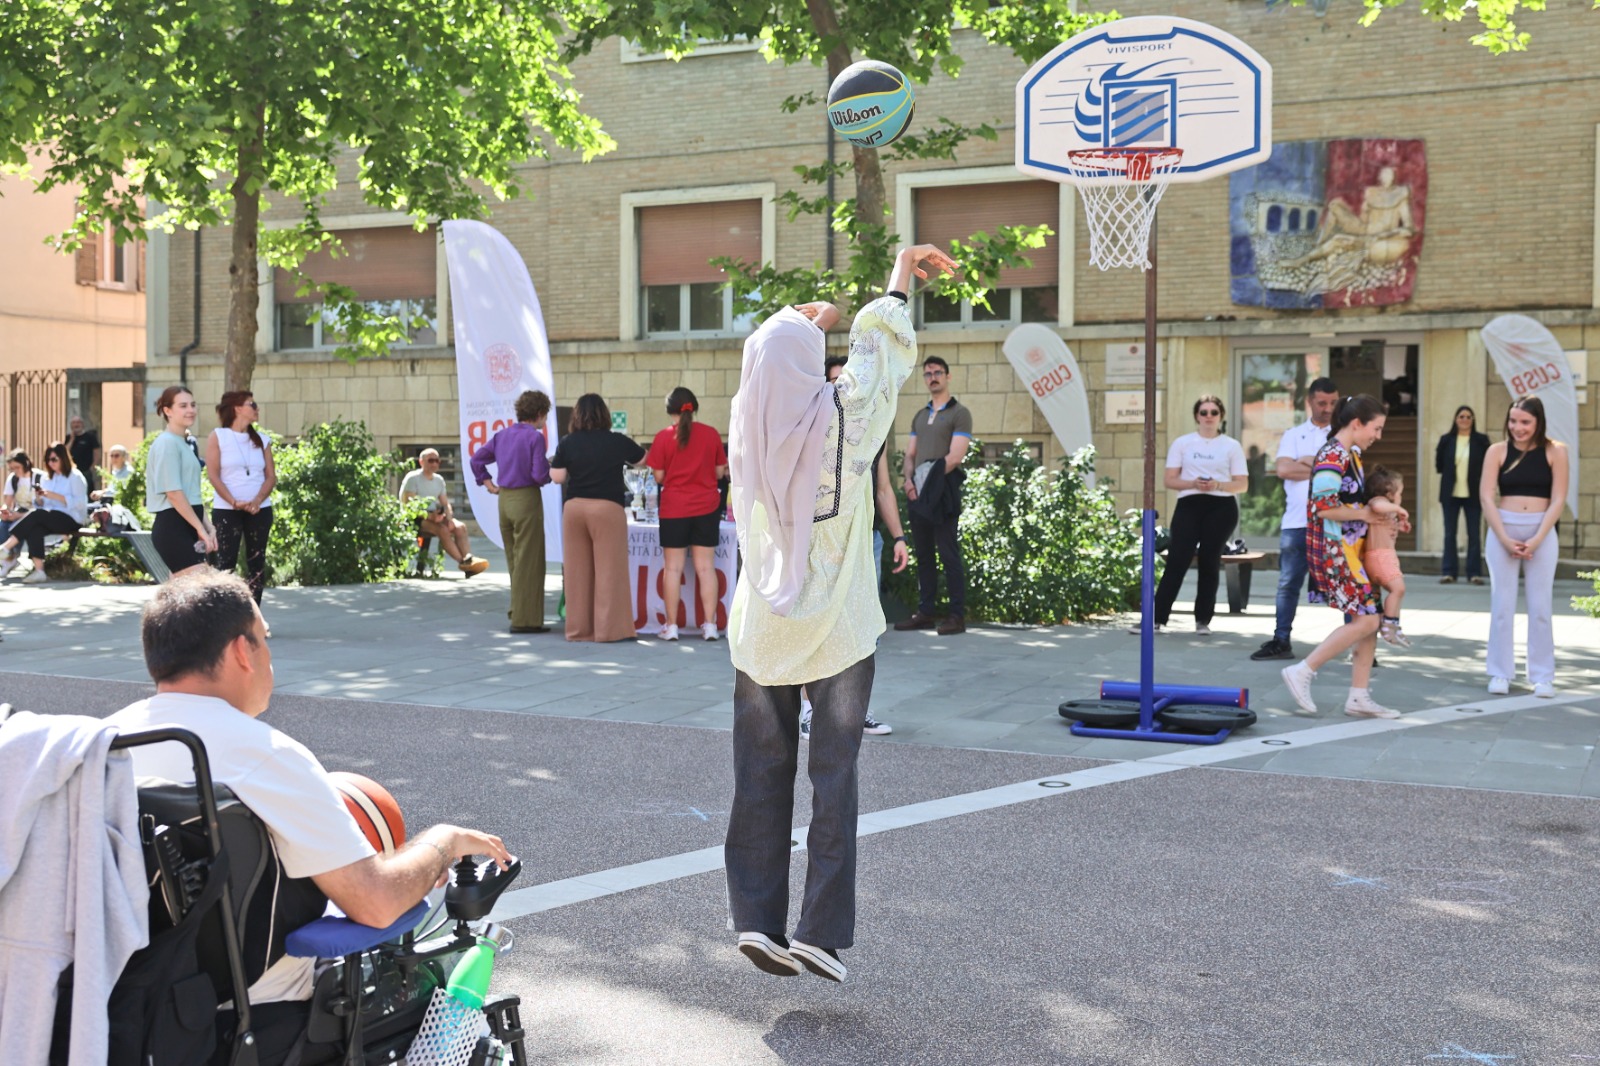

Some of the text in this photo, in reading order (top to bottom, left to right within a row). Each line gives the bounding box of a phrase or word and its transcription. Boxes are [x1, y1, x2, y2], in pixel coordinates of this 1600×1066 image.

[1107, 43, 1173, 54] VIVISPORT
[628, 532, 656, 543] ATER
[654, 546, 663, 557] D
